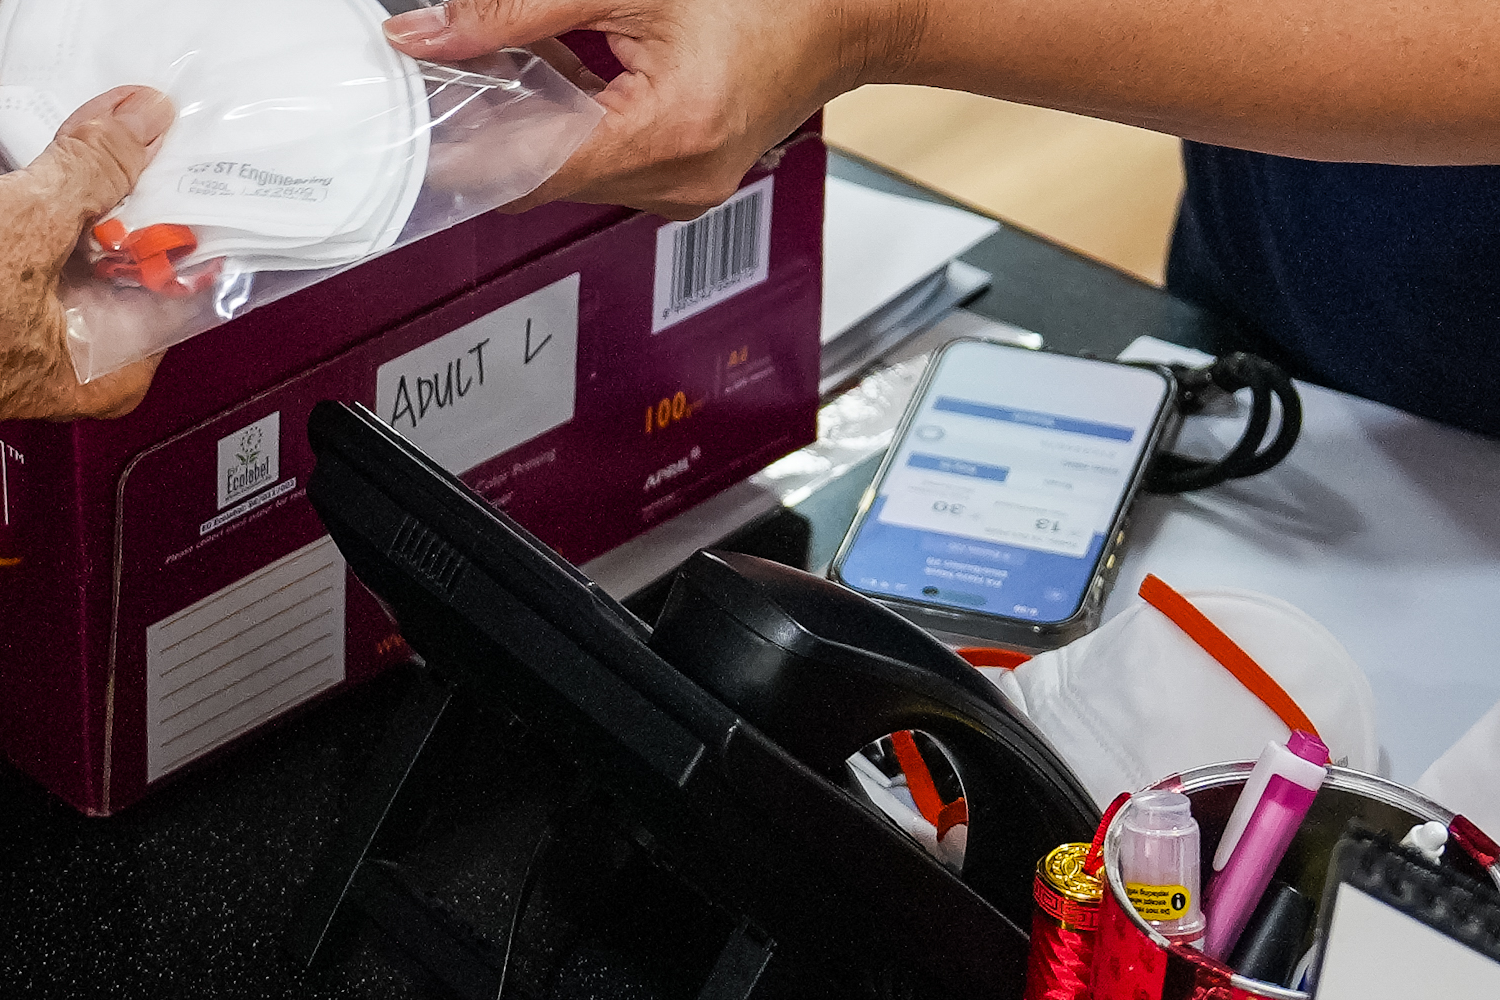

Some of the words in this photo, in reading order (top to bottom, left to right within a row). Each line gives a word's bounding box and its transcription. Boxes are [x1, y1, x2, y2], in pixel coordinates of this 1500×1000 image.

[214, 161, 239, 175] ST
[239, 163, 334, 187] Engineering
[391, 338, 490, 428] ADULT
[524, 317, 553, 365] L
[645, 391, 687, 434] 100
[227, 456, 270, 494] Ecolabel
